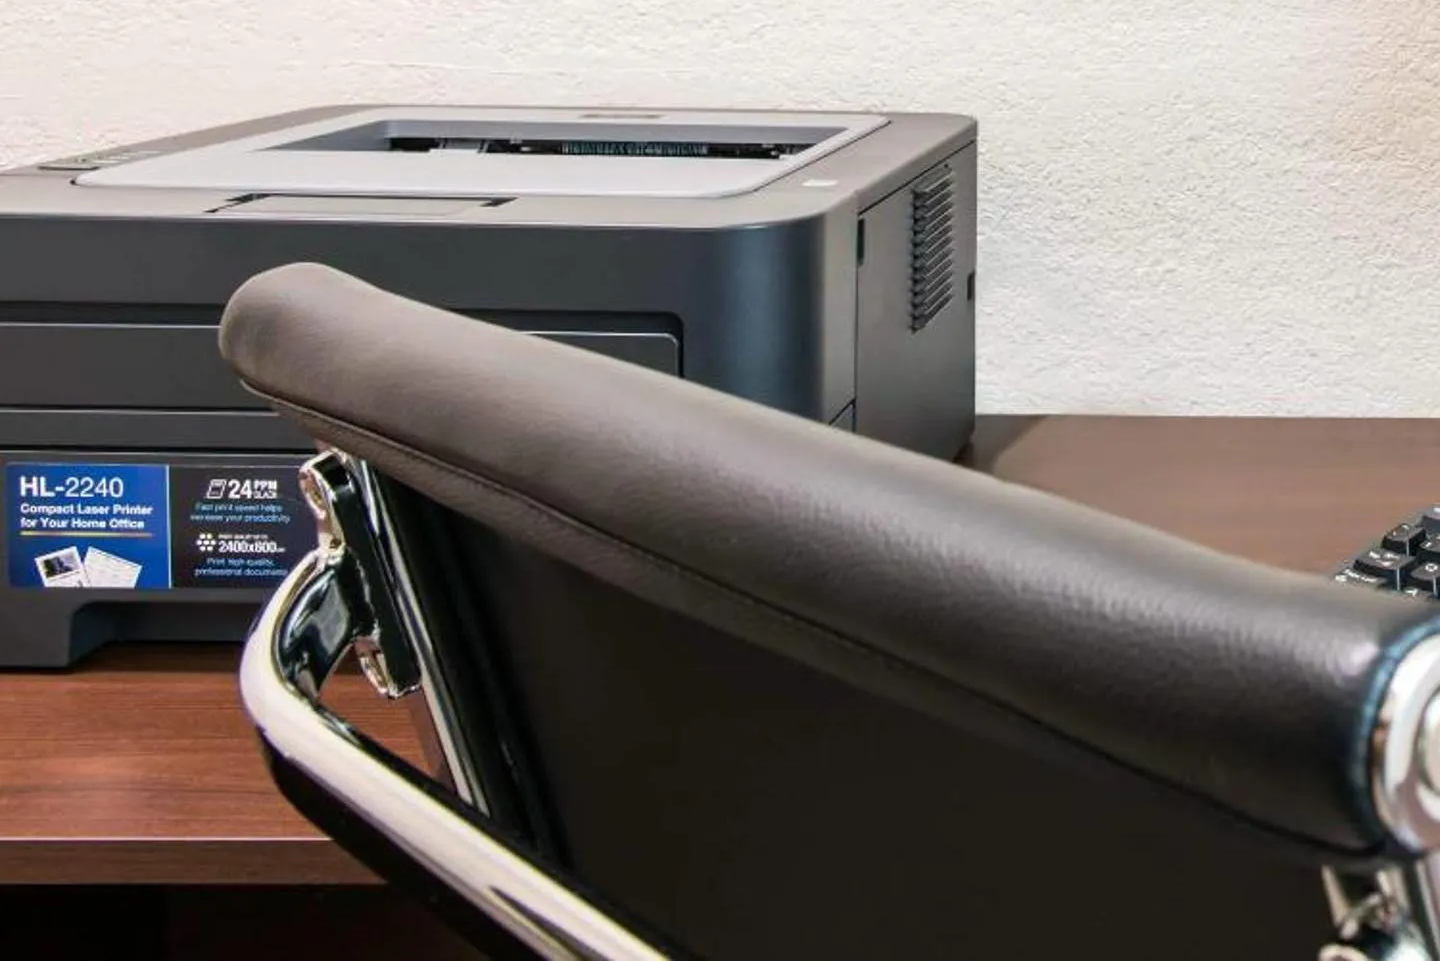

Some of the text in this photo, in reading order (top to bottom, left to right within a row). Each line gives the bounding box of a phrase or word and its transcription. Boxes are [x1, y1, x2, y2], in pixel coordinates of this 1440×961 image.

[20, 475, 124, 498] HL-2240
[228, 479, 252, 499] 24
[20, 503, 153, 516] Compact Laser Printer
[20, 517, 145, 529] for Your Home Office
